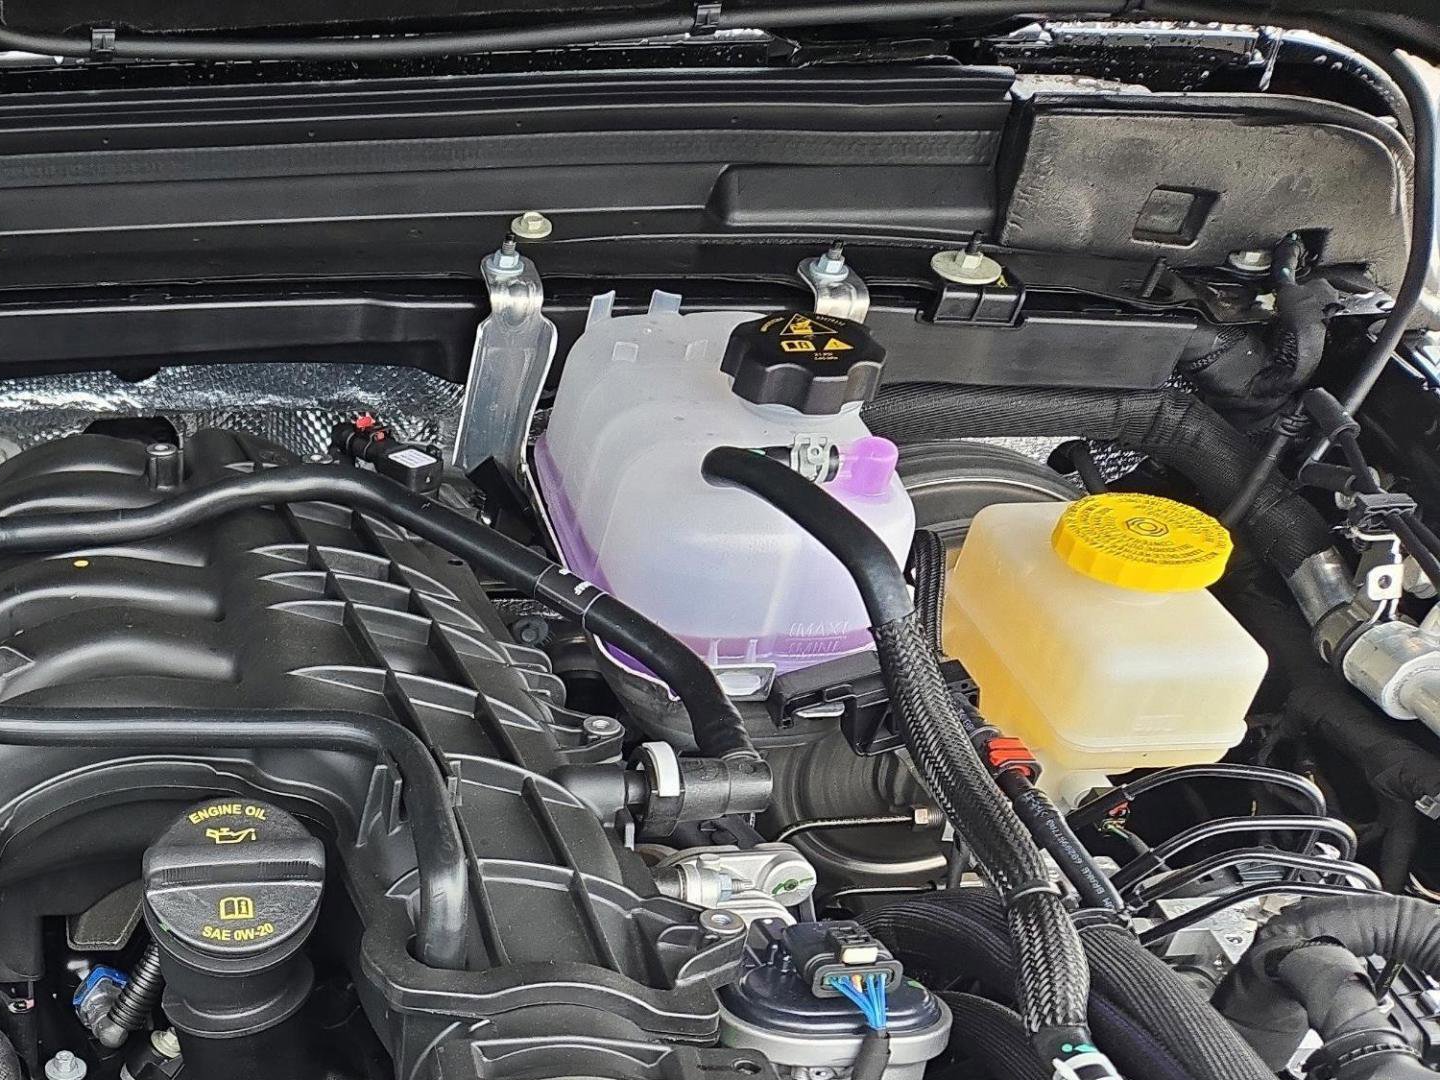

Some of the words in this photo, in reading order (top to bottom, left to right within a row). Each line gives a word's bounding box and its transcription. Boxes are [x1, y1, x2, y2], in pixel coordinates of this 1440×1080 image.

[188, 804, 242, 824] ENGINE
[245, 805, 267, 821] OIL
[202, 926, 231, 942] SAE
[233, 923, 274, 942] 0W-20
